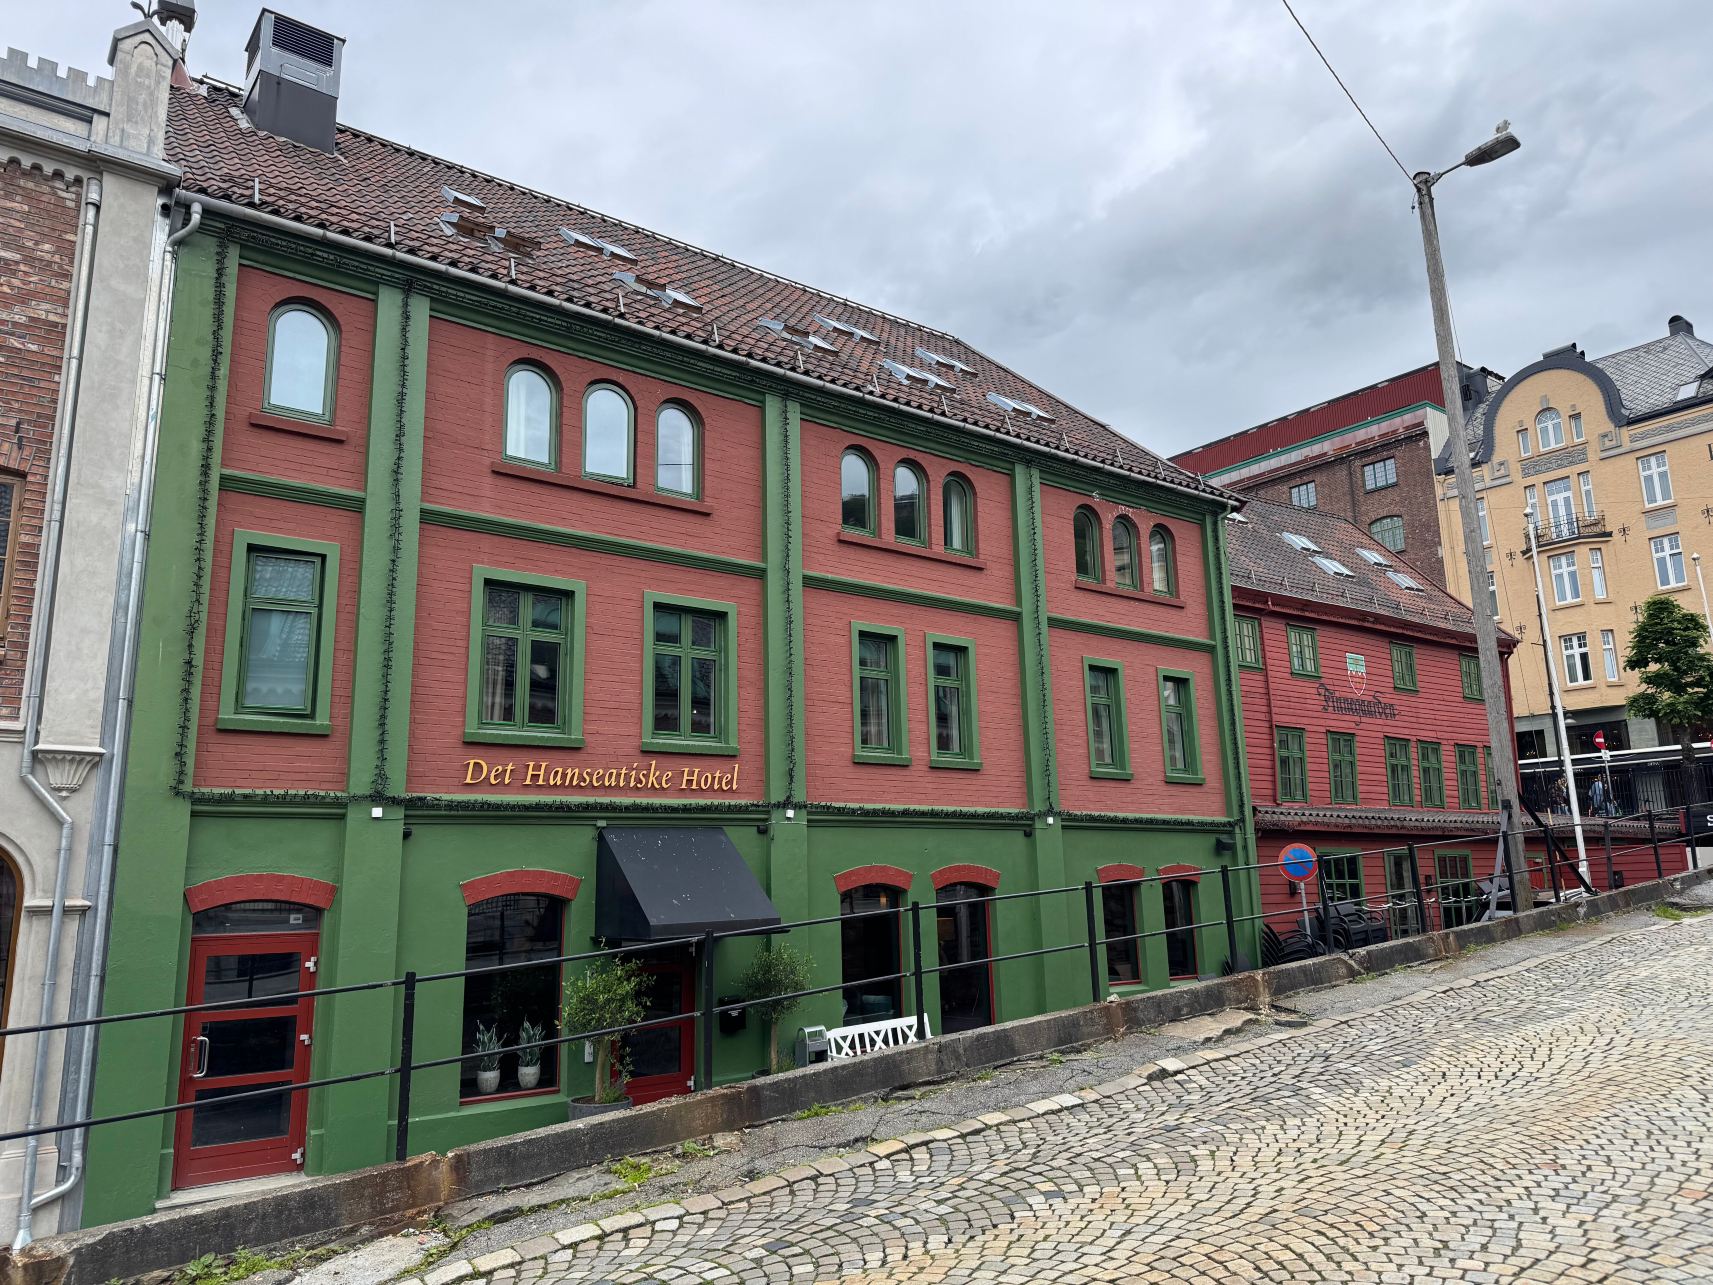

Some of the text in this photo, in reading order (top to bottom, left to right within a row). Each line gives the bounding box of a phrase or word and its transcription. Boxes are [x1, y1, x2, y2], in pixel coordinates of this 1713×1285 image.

[463, 759, 740, 791] Det Hanseatiske Hotel
